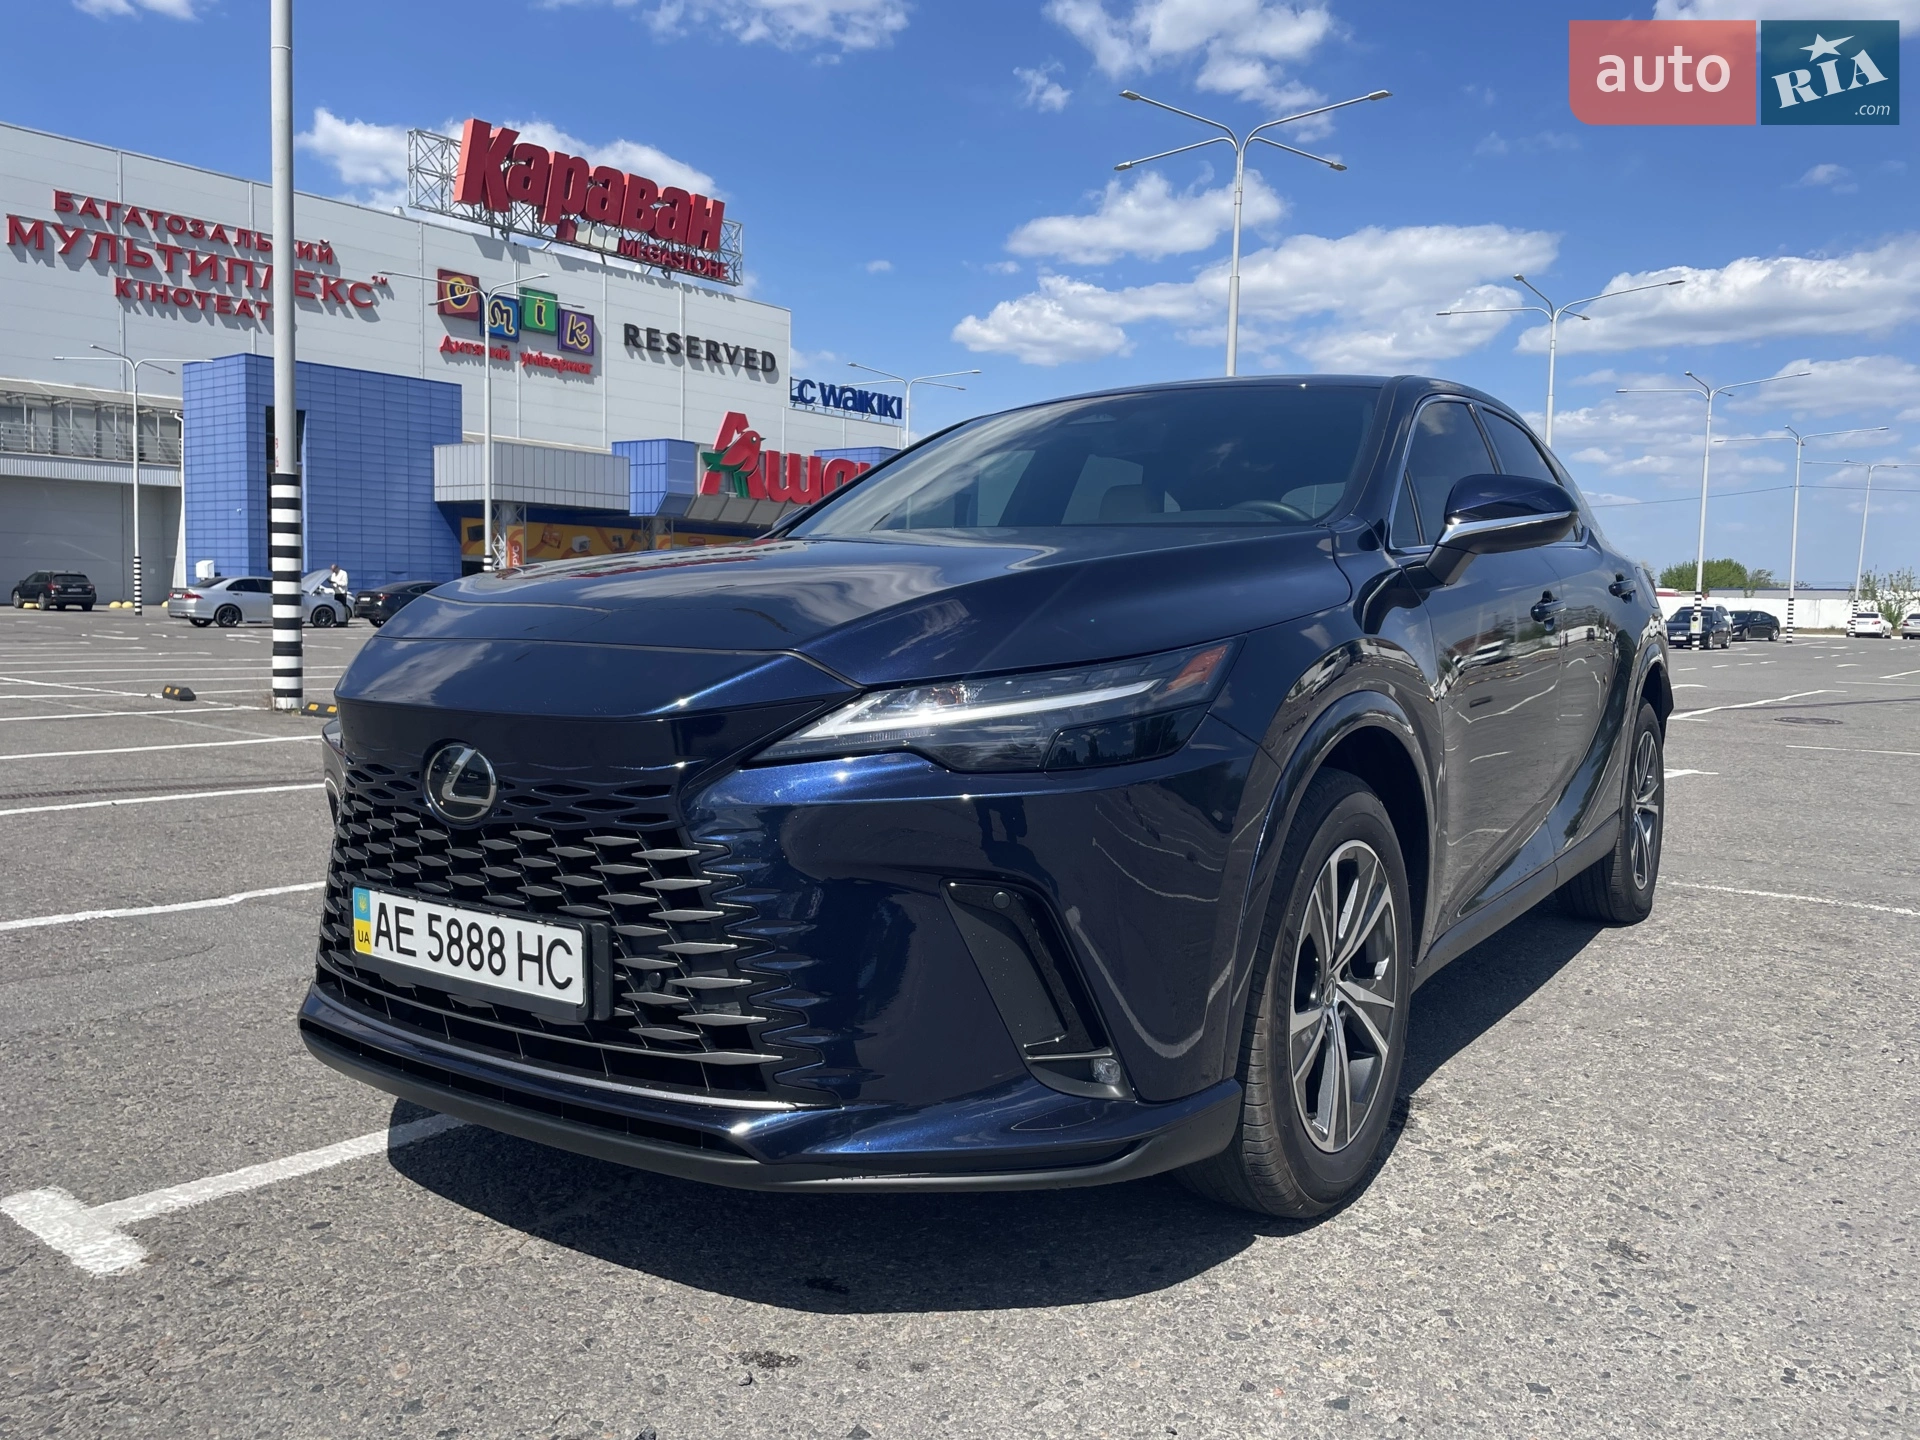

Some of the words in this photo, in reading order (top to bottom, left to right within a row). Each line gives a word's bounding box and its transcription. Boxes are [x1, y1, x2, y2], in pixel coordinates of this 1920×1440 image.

[454, 118, 725, 251] Караван
[53, 189, 333, 265] БАГАТОЗАЛЬИЙ
[617, 237, 729, 280] MEGASTORE
[115, 276, 272, 320] КІНОТЕАТ
[439, 335, 511, 361] Дитяий
[624, 323, 777, 373] RESERVED
[358, 929, 371, 945] UA
[374, 902, 417, 957] AE
[427, 912, 506, 976] 5888
[517, 930, 573, 990] HC
